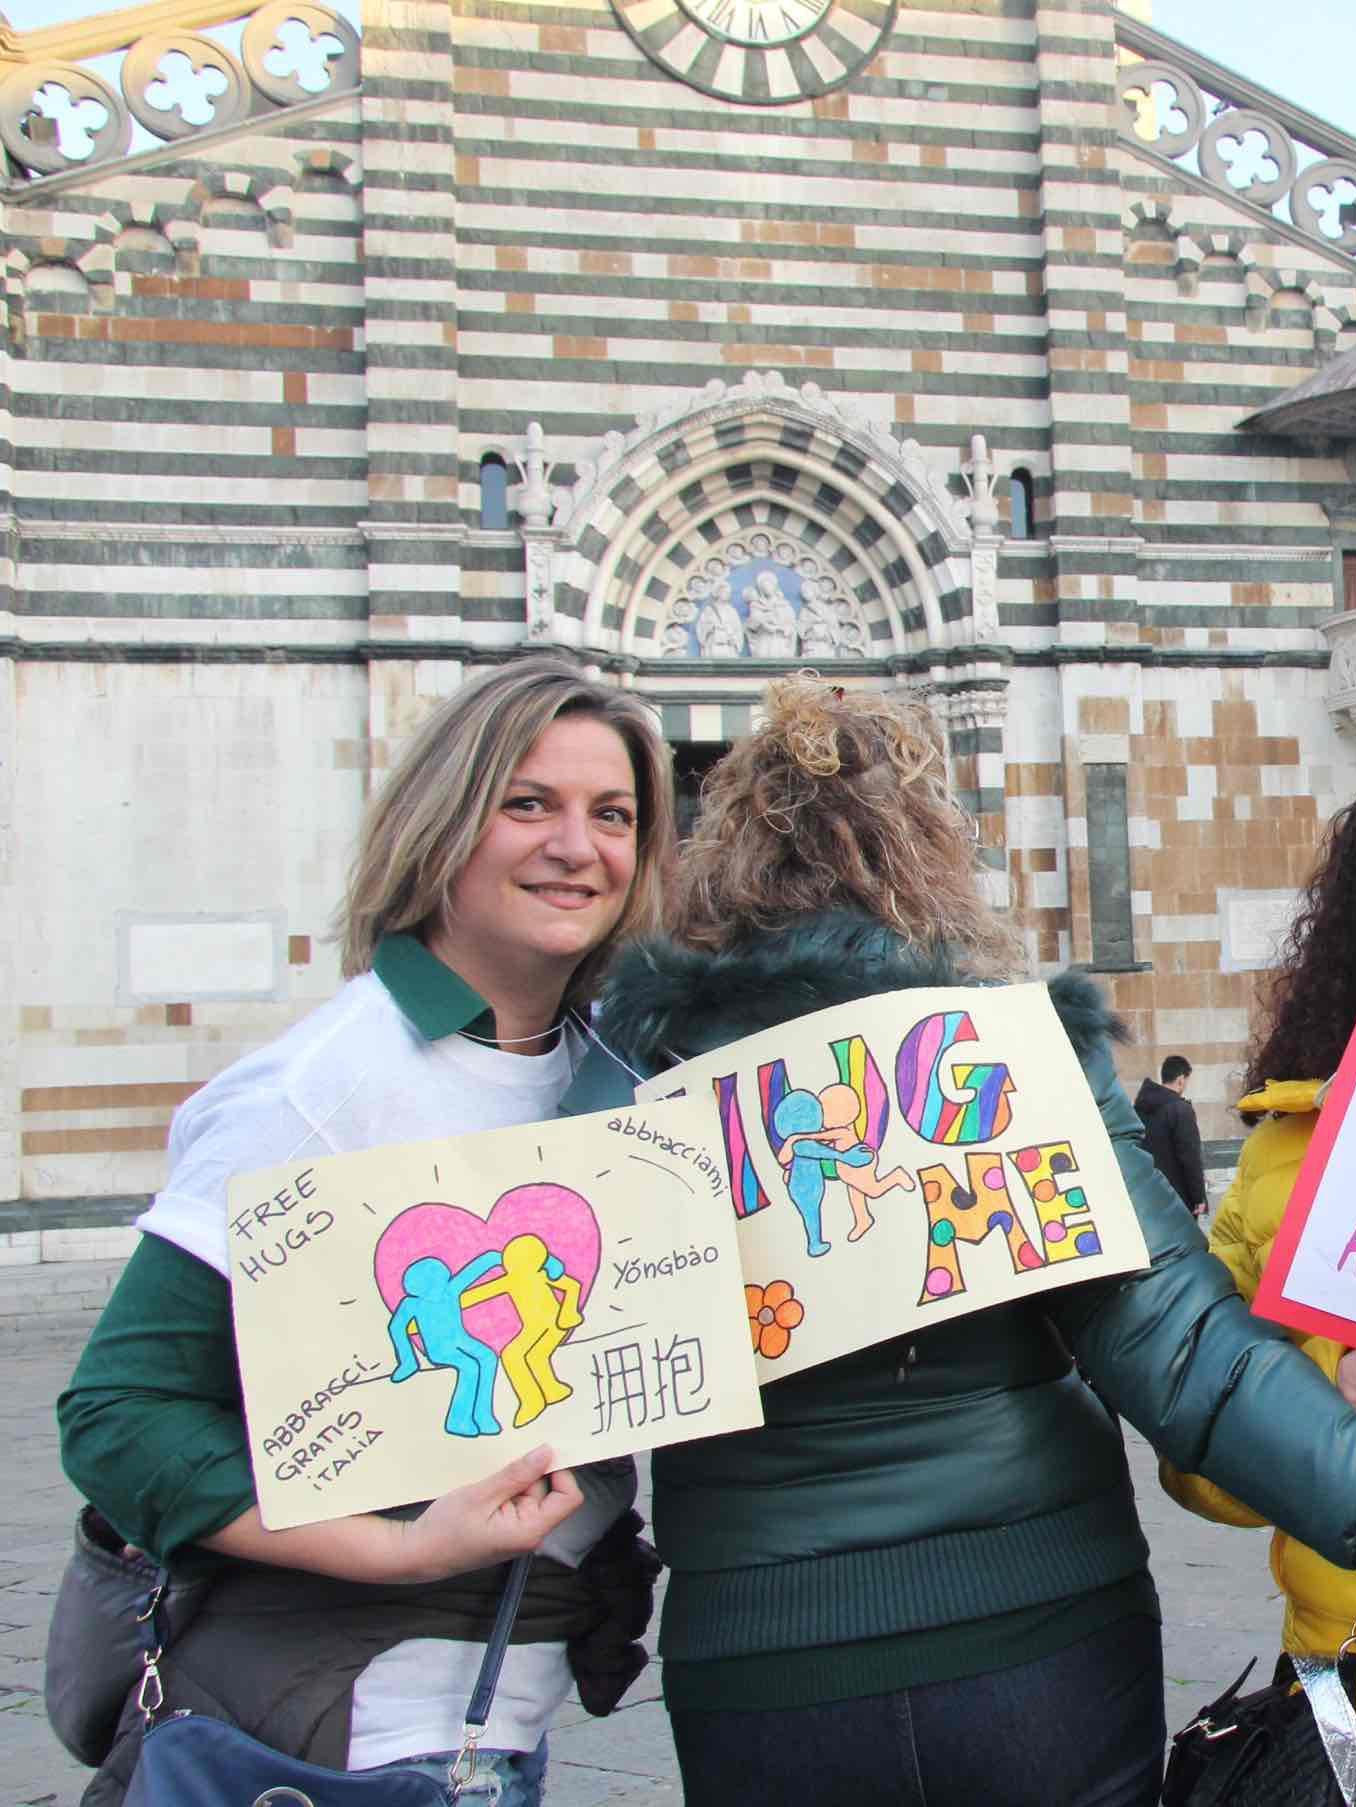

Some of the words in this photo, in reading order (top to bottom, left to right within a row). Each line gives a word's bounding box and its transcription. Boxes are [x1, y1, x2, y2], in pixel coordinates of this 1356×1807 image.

[607, 1116, 729, 1198] abbracciami
[228, 1167, 317, 1240] FREE
[917, 1140, 1103, 1307] ME
[238, 1210, 335, 1282] HUGS
[590, 1333, 711, 1436] 拥抱
[274, 1410, 362, 1481] GRATIS
